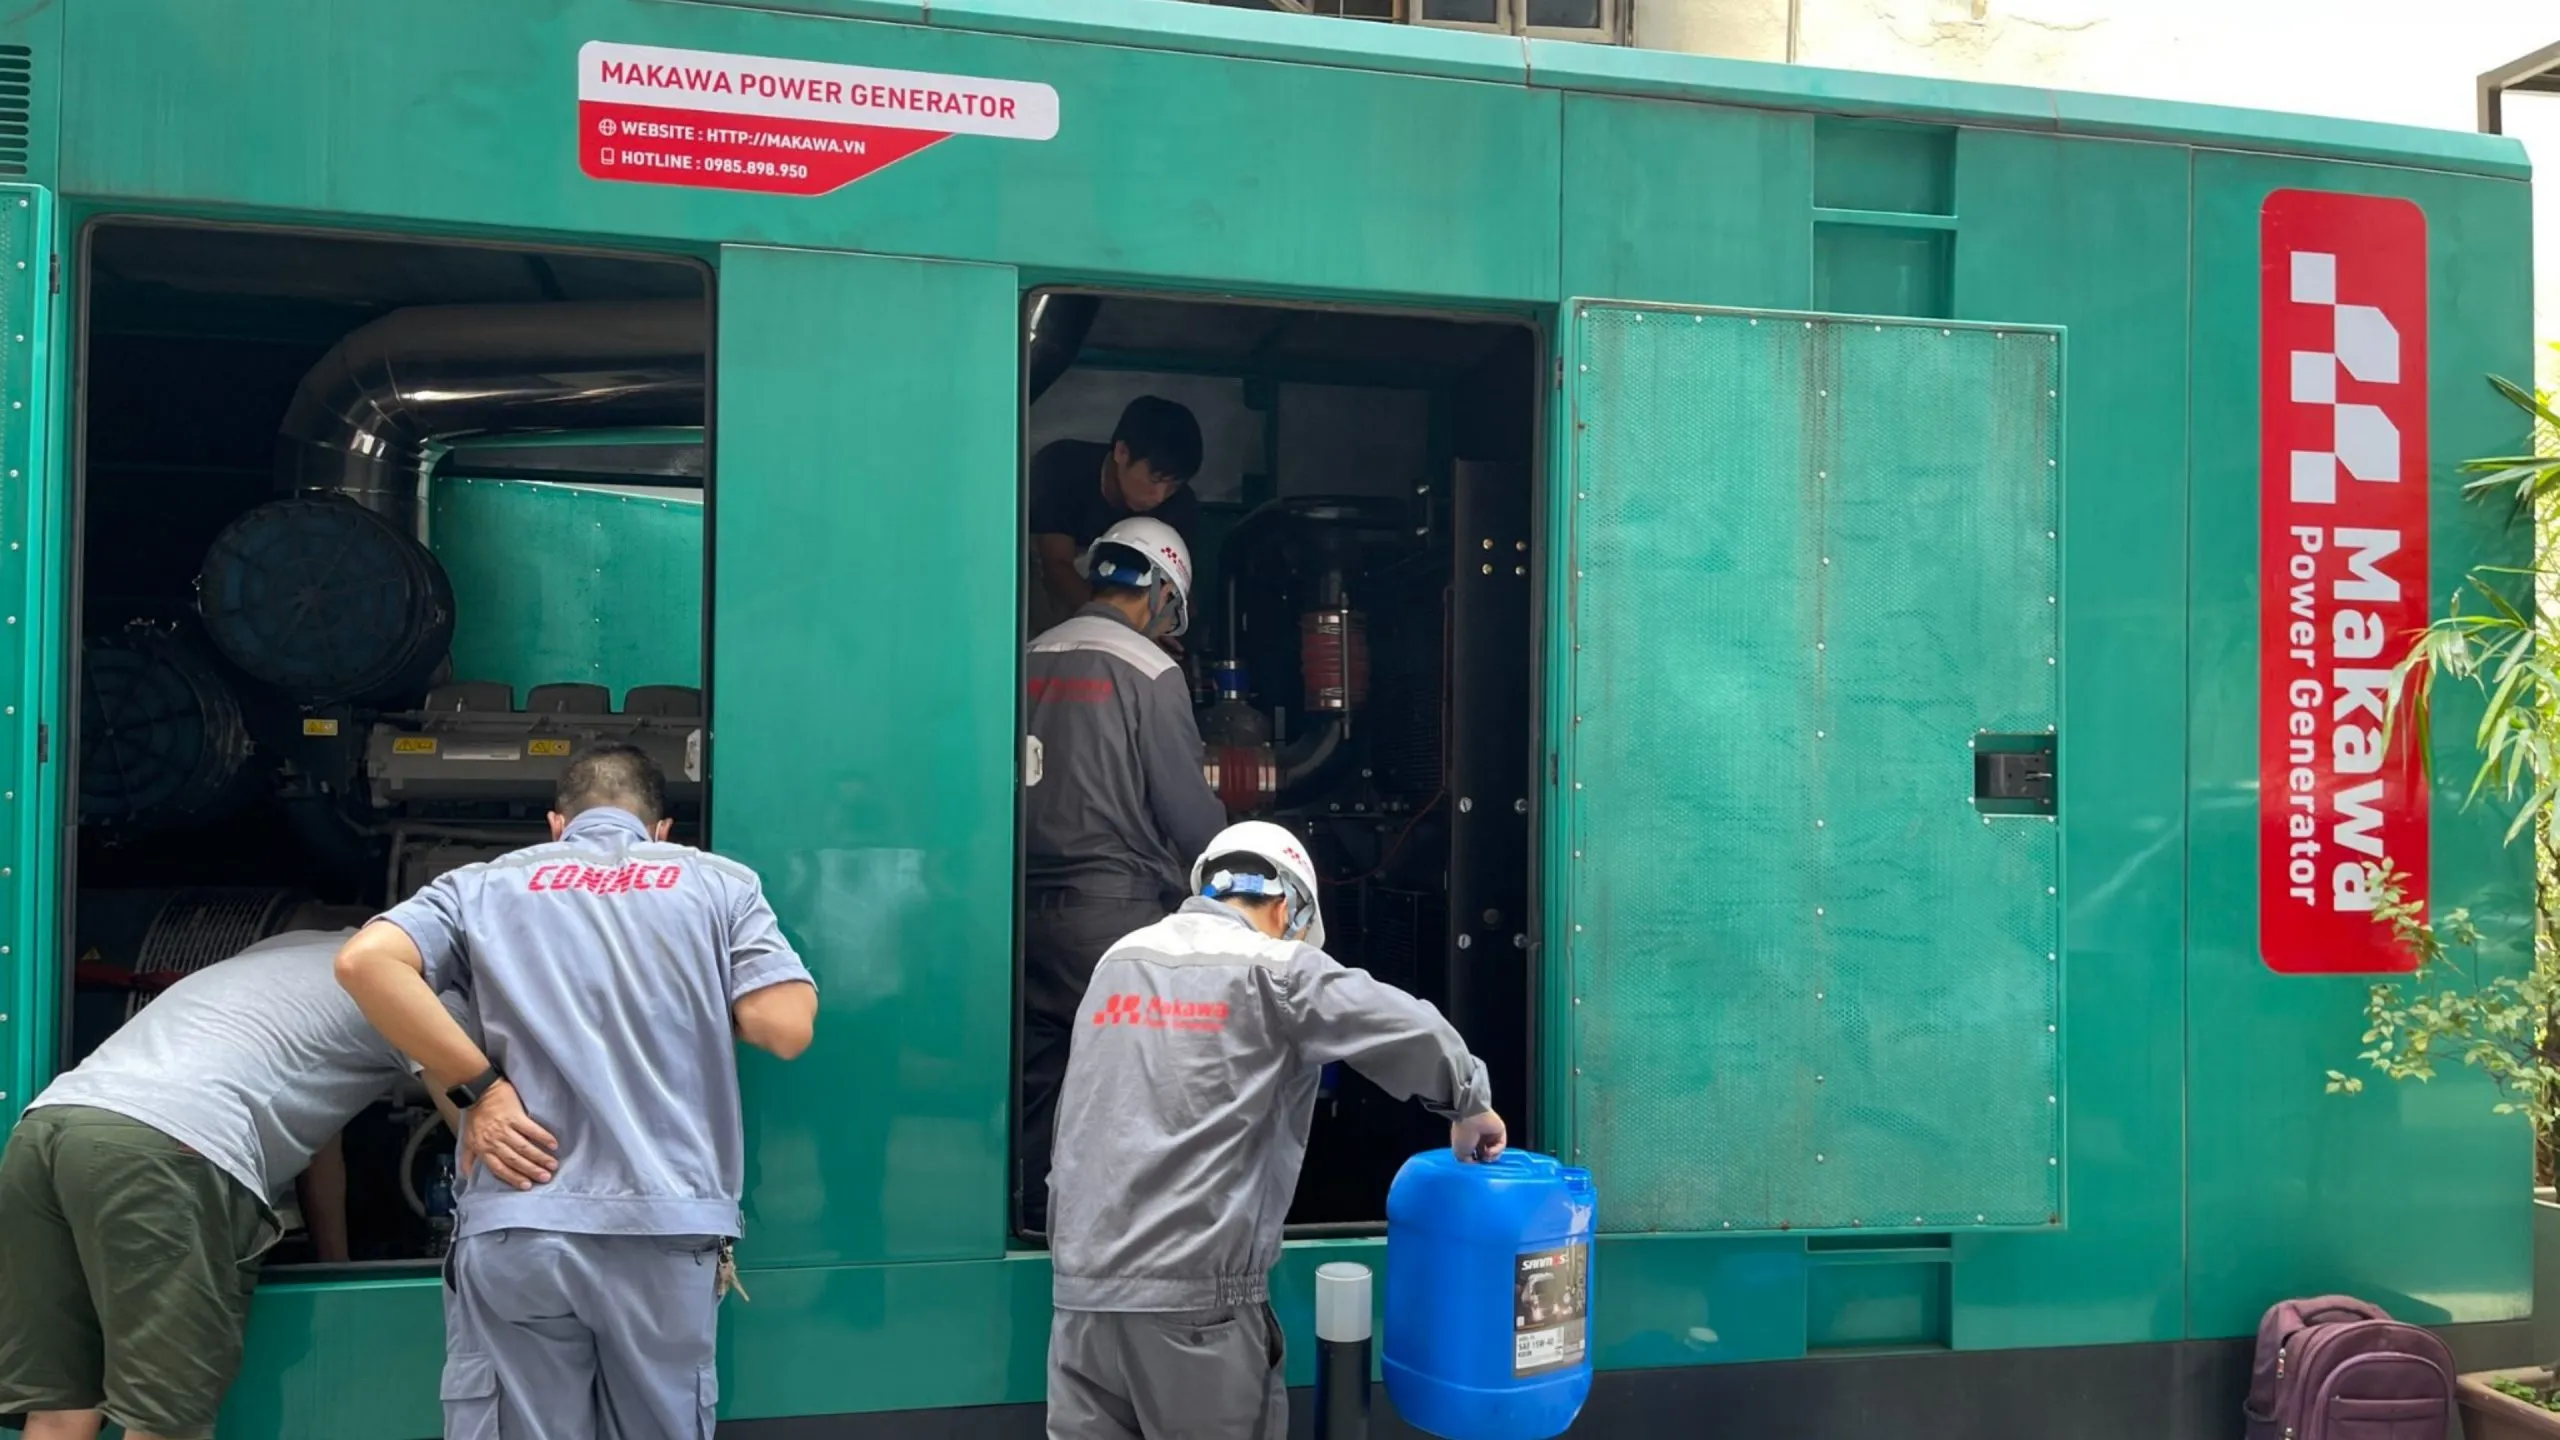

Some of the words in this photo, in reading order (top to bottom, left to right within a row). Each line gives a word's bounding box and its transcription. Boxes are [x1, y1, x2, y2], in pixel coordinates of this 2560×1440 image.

[601, 60, 732, 94] MAKAWA
[740, 73, 842, 104] POWER
[850, 83, 1016, 119] GENERATOR
[621, 120, 694, 141] WEBSITE
[706, 129, 866, 155] HTTP://MAKAWA.VN
[621, 150, 692, 170] HOTLINE
[704, 157, 808, 179] 0985.898.950
[2289, 525, 2324, 669] Power
[2331, 526, 2400, 912] Makawa
[2289, 678, 2324, 907] Generator
